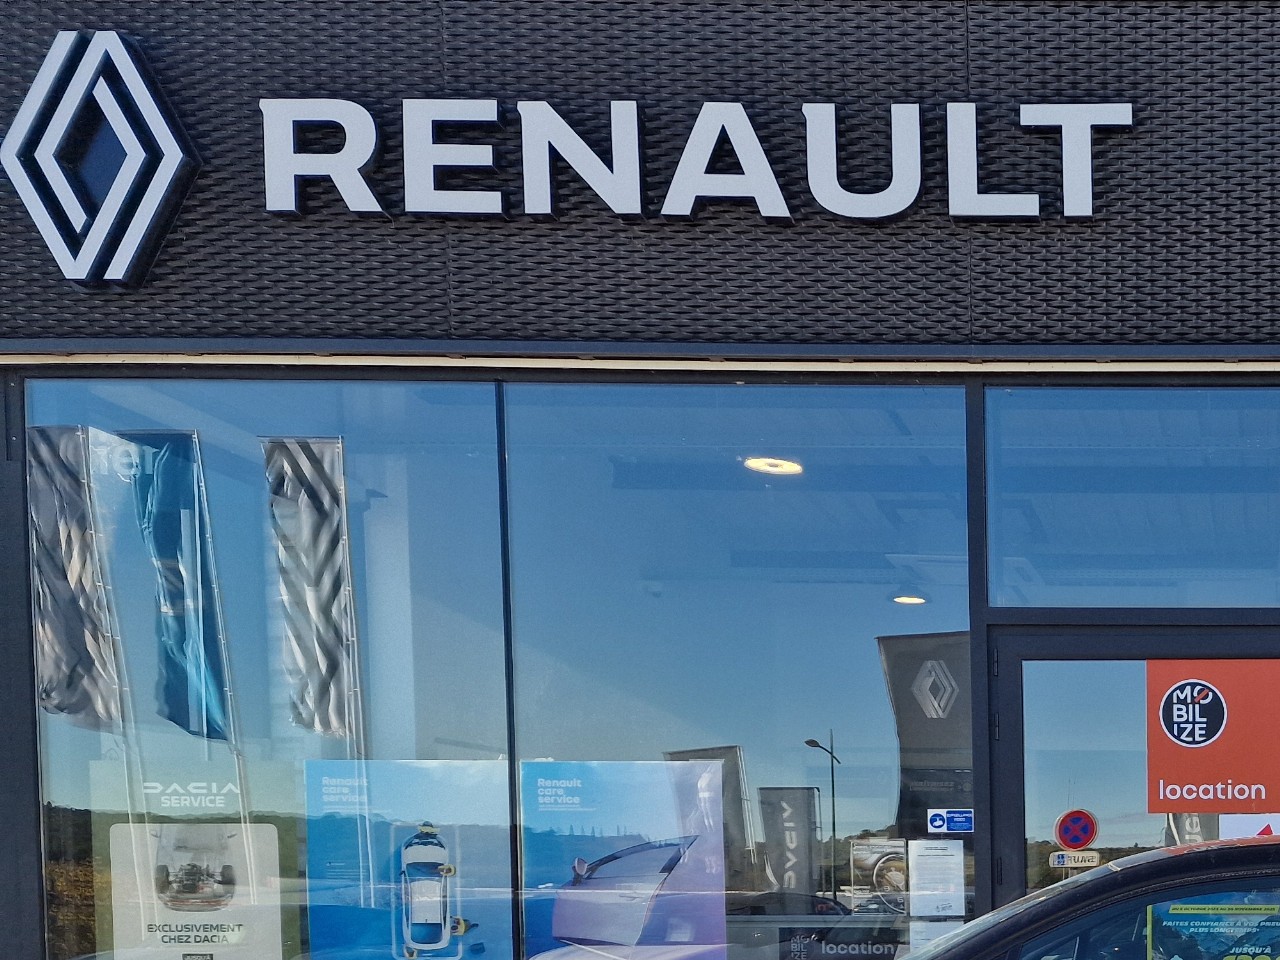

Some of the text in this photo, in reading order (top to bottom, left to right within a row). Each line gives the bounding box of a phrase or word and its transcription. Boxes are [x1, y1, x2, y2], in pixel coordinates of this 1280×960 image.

[259, 98, 1133, 218] RENAULT
[143, 782, 240, 794] DACIA
[537, 778, 582, 787] Renault
[1159, 779, 1266, 799] location
[161, 795, 225, 807] SERVICE
[538, 795, 580, 804] service
[148, 924, 244, 933] EXCLUSIVEMENT
[161, 935, 229, 944] CHEZ DACIA
[821, 941, 895, 955] location
